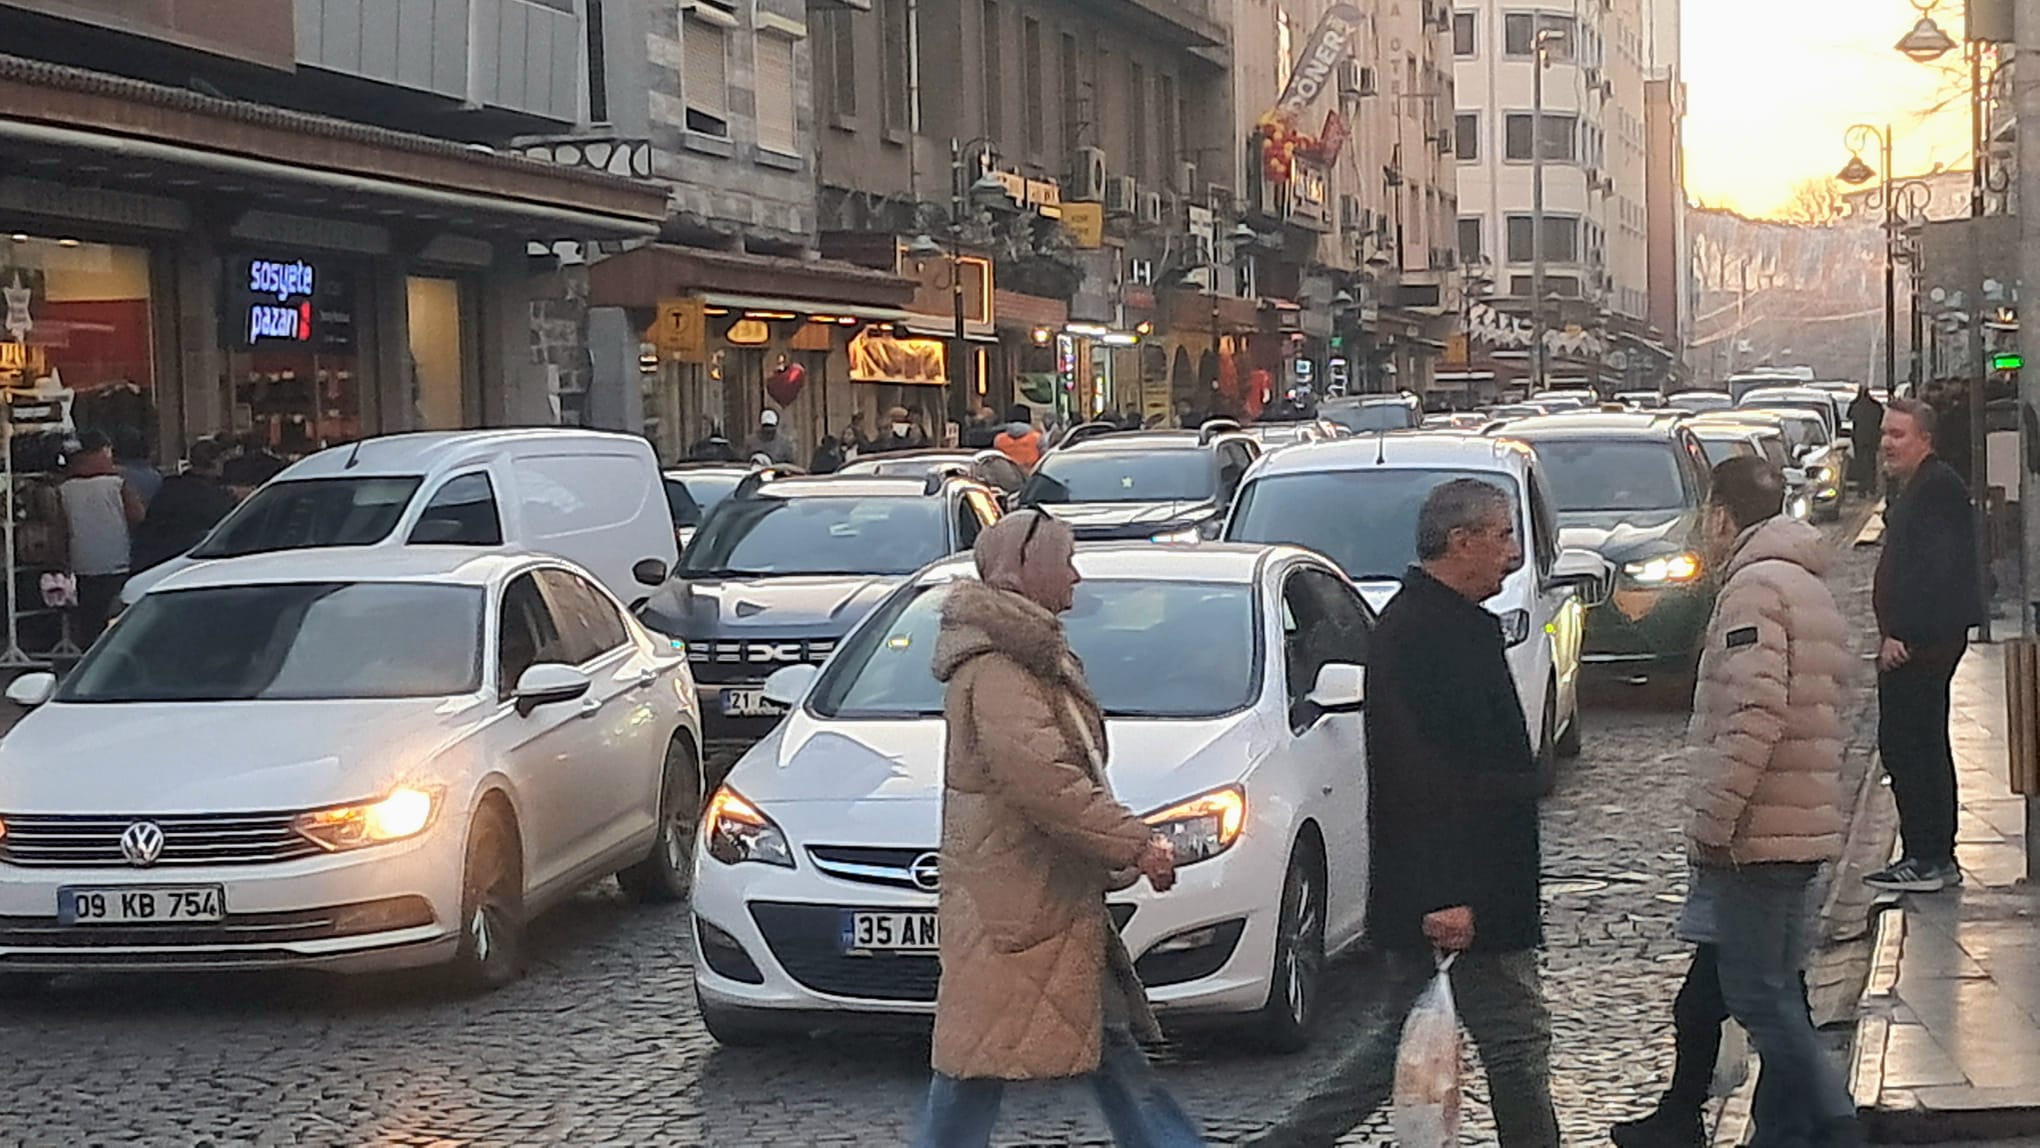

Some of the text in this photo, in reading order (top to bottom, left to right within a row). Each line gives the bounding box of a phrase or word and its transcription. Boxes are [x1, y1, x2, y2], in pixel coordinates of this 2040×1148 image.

[1286, 30, 1346, 112] DÖNER
[250, 260, 313, 302] sosyete
[732, 692, 749, 709] 21
[76, 891, 217, 918] 09 KB 754
[859, 916, 935, 945] 35 AN
